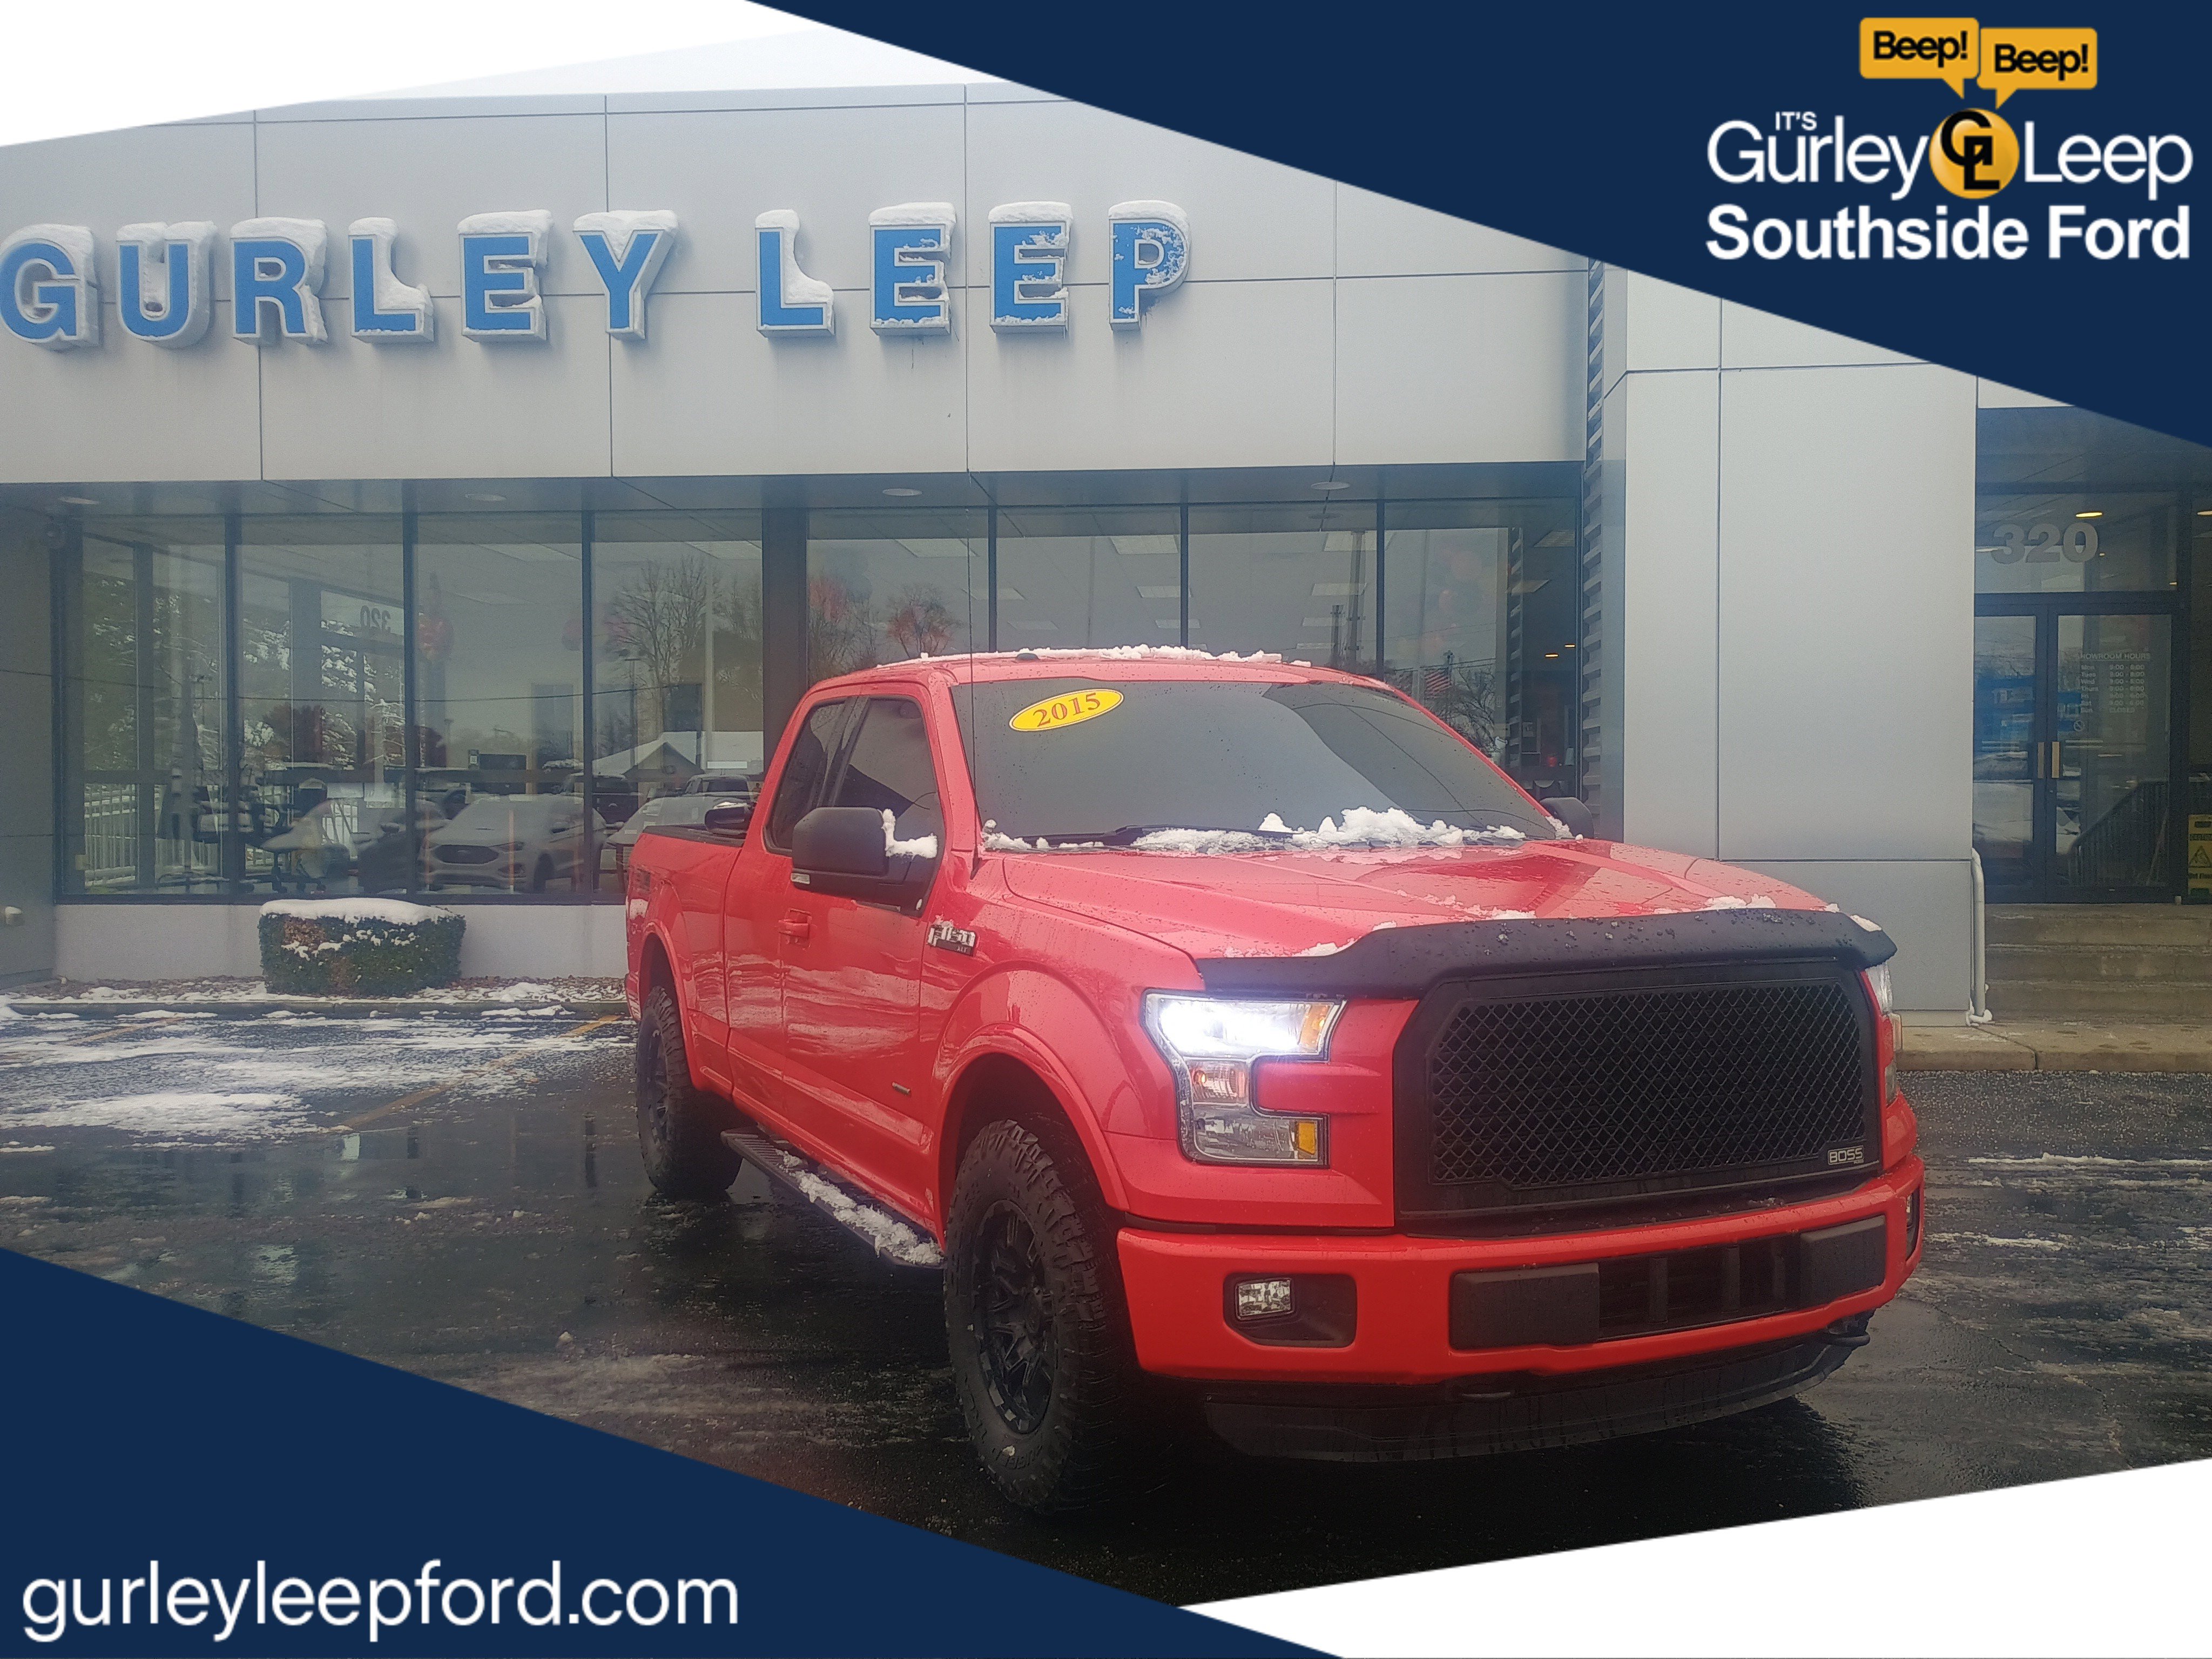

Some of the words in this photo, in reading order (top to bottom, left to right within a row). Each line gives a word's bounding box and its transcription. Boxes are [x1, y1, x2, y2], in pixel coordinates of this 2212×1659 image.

[0, 224, 672, 348] GURLEY
[755, 216, 1189, 335] LEEP
[1991, 522, 2098, 564] 320
[1032, 692, 1101, 727] 2015
[1829, 1147, 1864, 1163] BOSS
